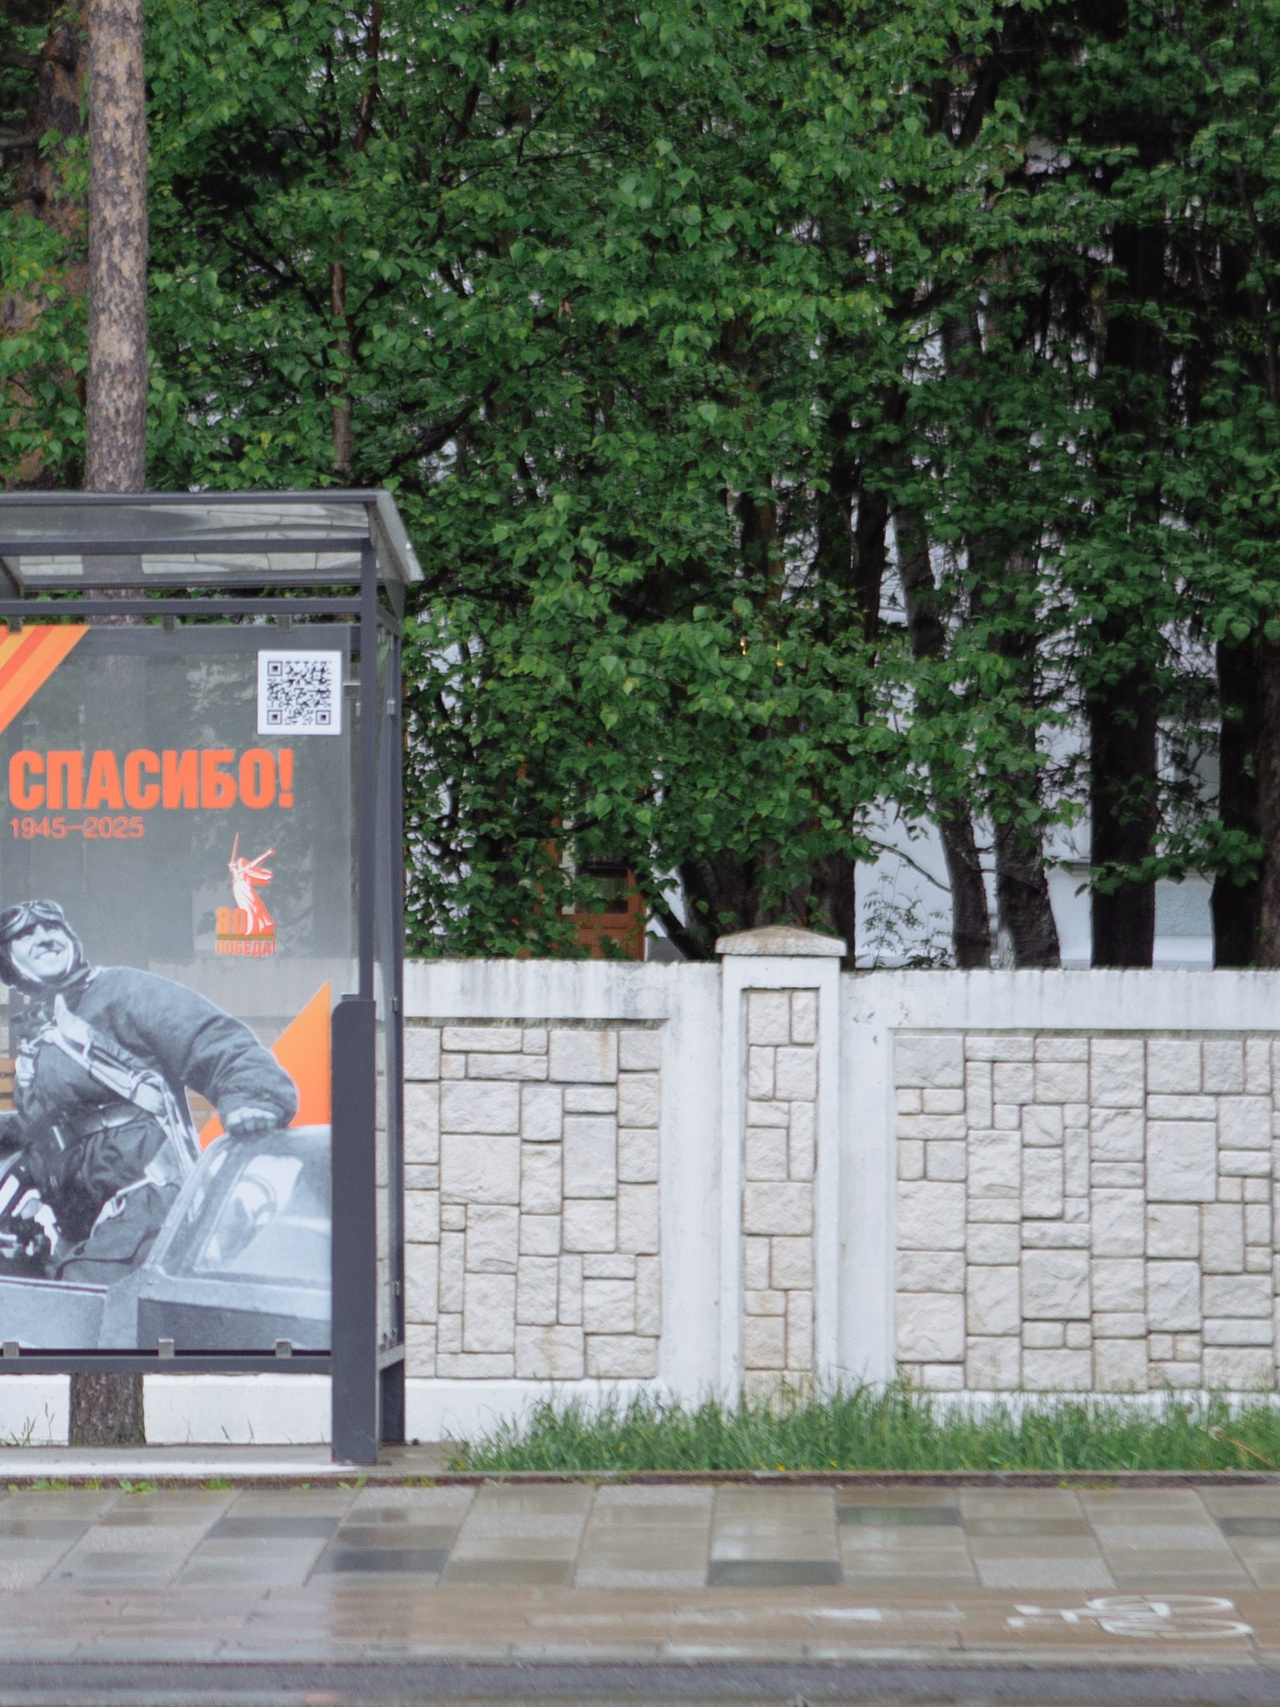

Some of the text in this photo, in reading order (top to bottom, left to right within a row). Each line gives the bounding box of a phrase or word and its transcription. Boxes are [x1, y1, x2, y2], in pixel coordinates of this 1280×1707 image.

[9, 748, 294, 811] СПАСИБО!
[215, 906, 248, 935] 80
[215, 940, 277, 957] ПОБЕДА!
